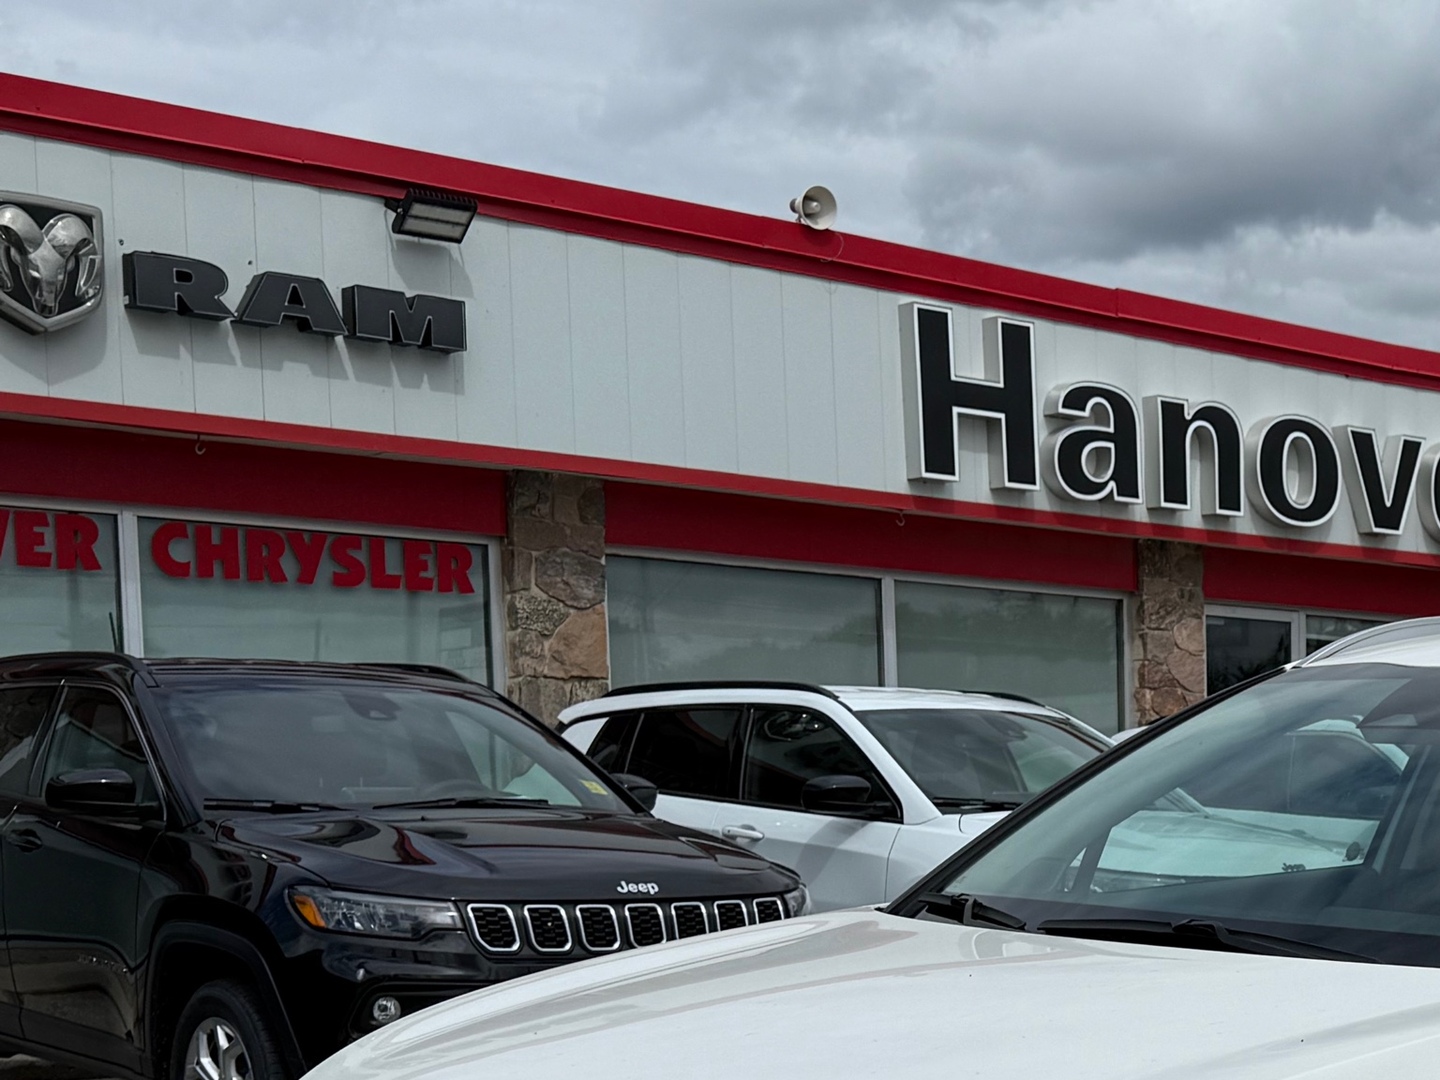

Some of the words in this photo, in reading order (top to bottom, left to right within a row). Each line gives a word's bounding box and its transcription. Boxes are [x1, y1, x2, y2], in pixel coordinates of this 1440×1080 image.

[122, 250, 468, 353] RAM
[0, 509, 102, 572] ER
[150, 521, 476, 595] CHRYSLER
[616, 880, 659, 896] Jeep
